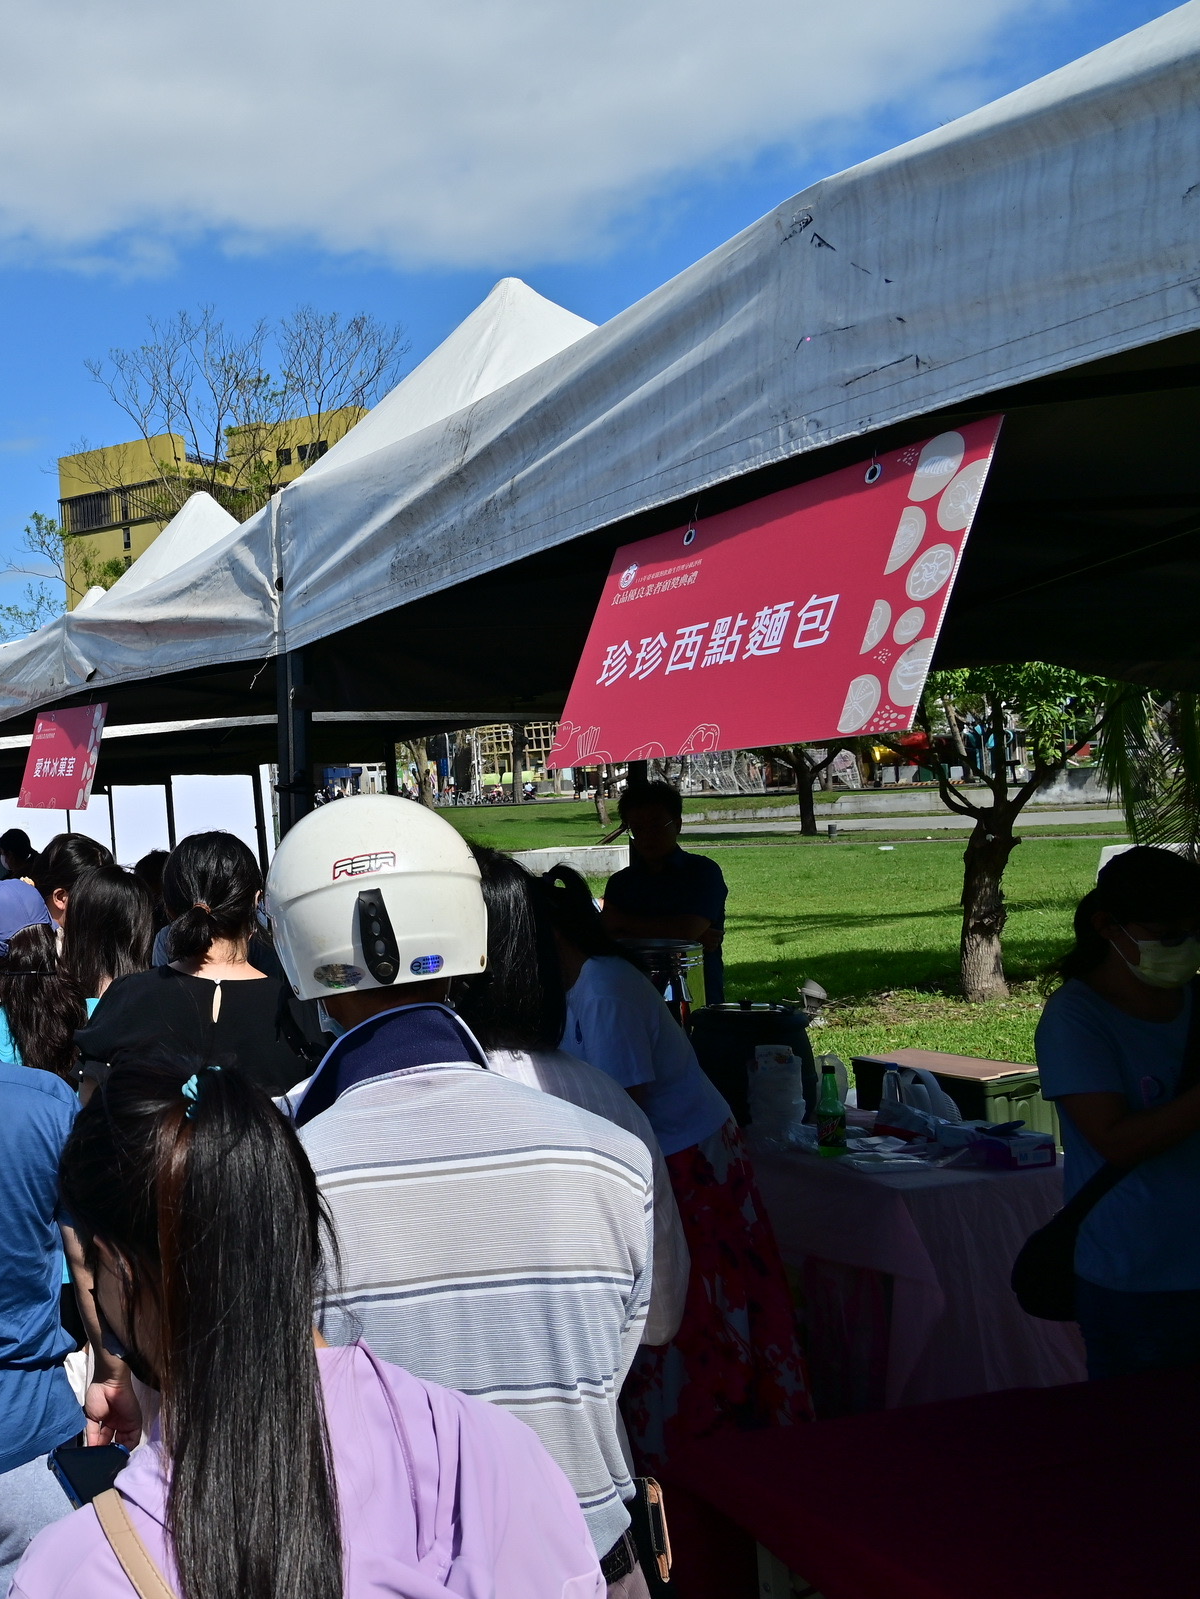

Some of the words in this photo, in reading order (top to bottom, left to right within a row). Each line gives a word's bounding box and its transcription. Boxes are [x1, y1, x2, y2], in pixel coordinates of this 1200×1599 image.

[595, 593, 840, 687] 珍珍西點麵包
